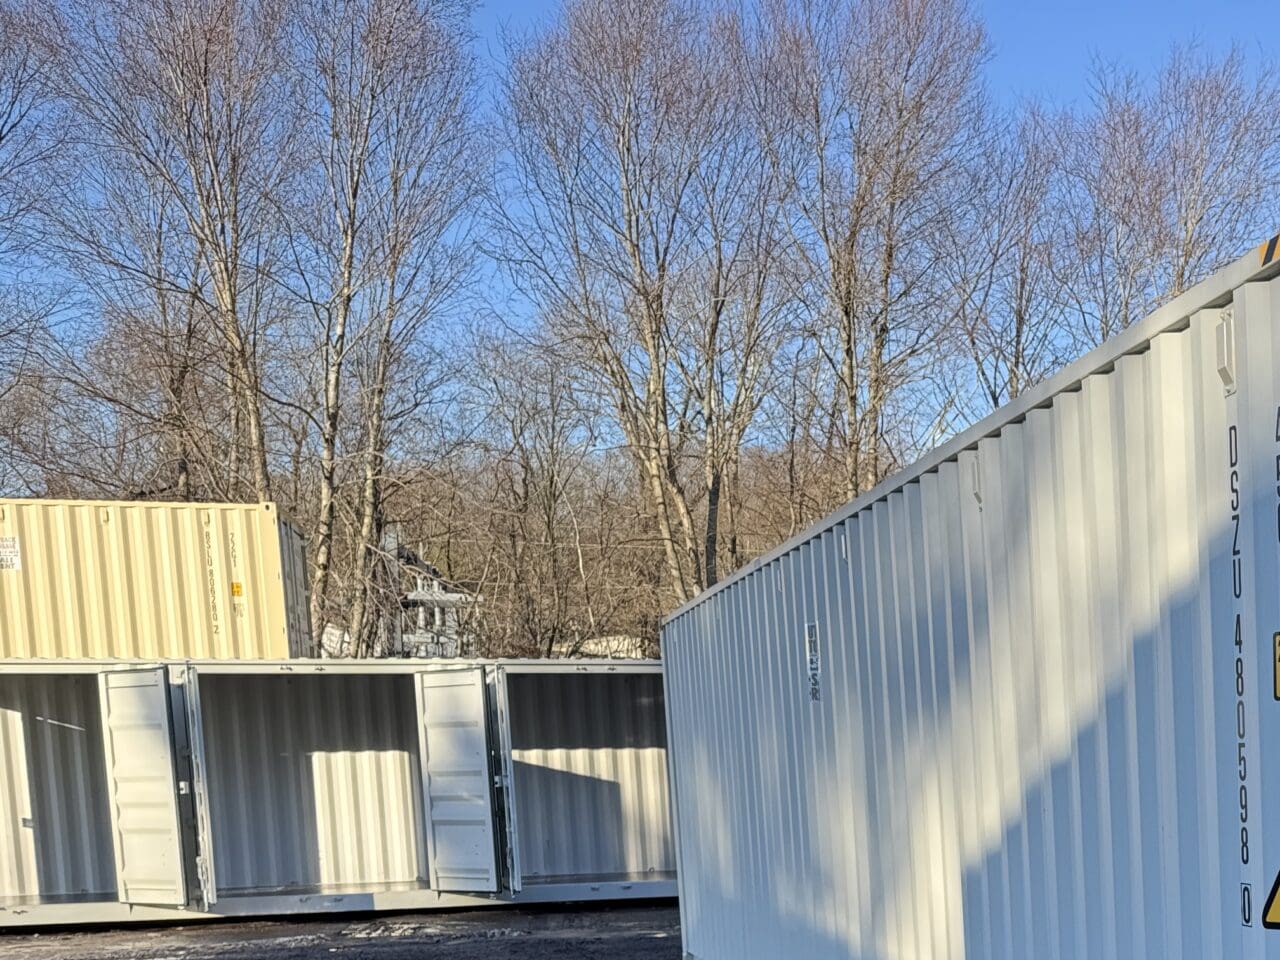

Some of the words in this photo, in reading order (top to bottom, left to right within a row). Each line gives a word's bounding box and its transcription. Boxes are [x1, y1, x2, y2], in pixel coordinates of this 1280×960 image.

[1229, 425, 1242, 599] DSZU
[1235, 614, 1250, 865] 480598
[1242, 884, 1252, 926] 0
